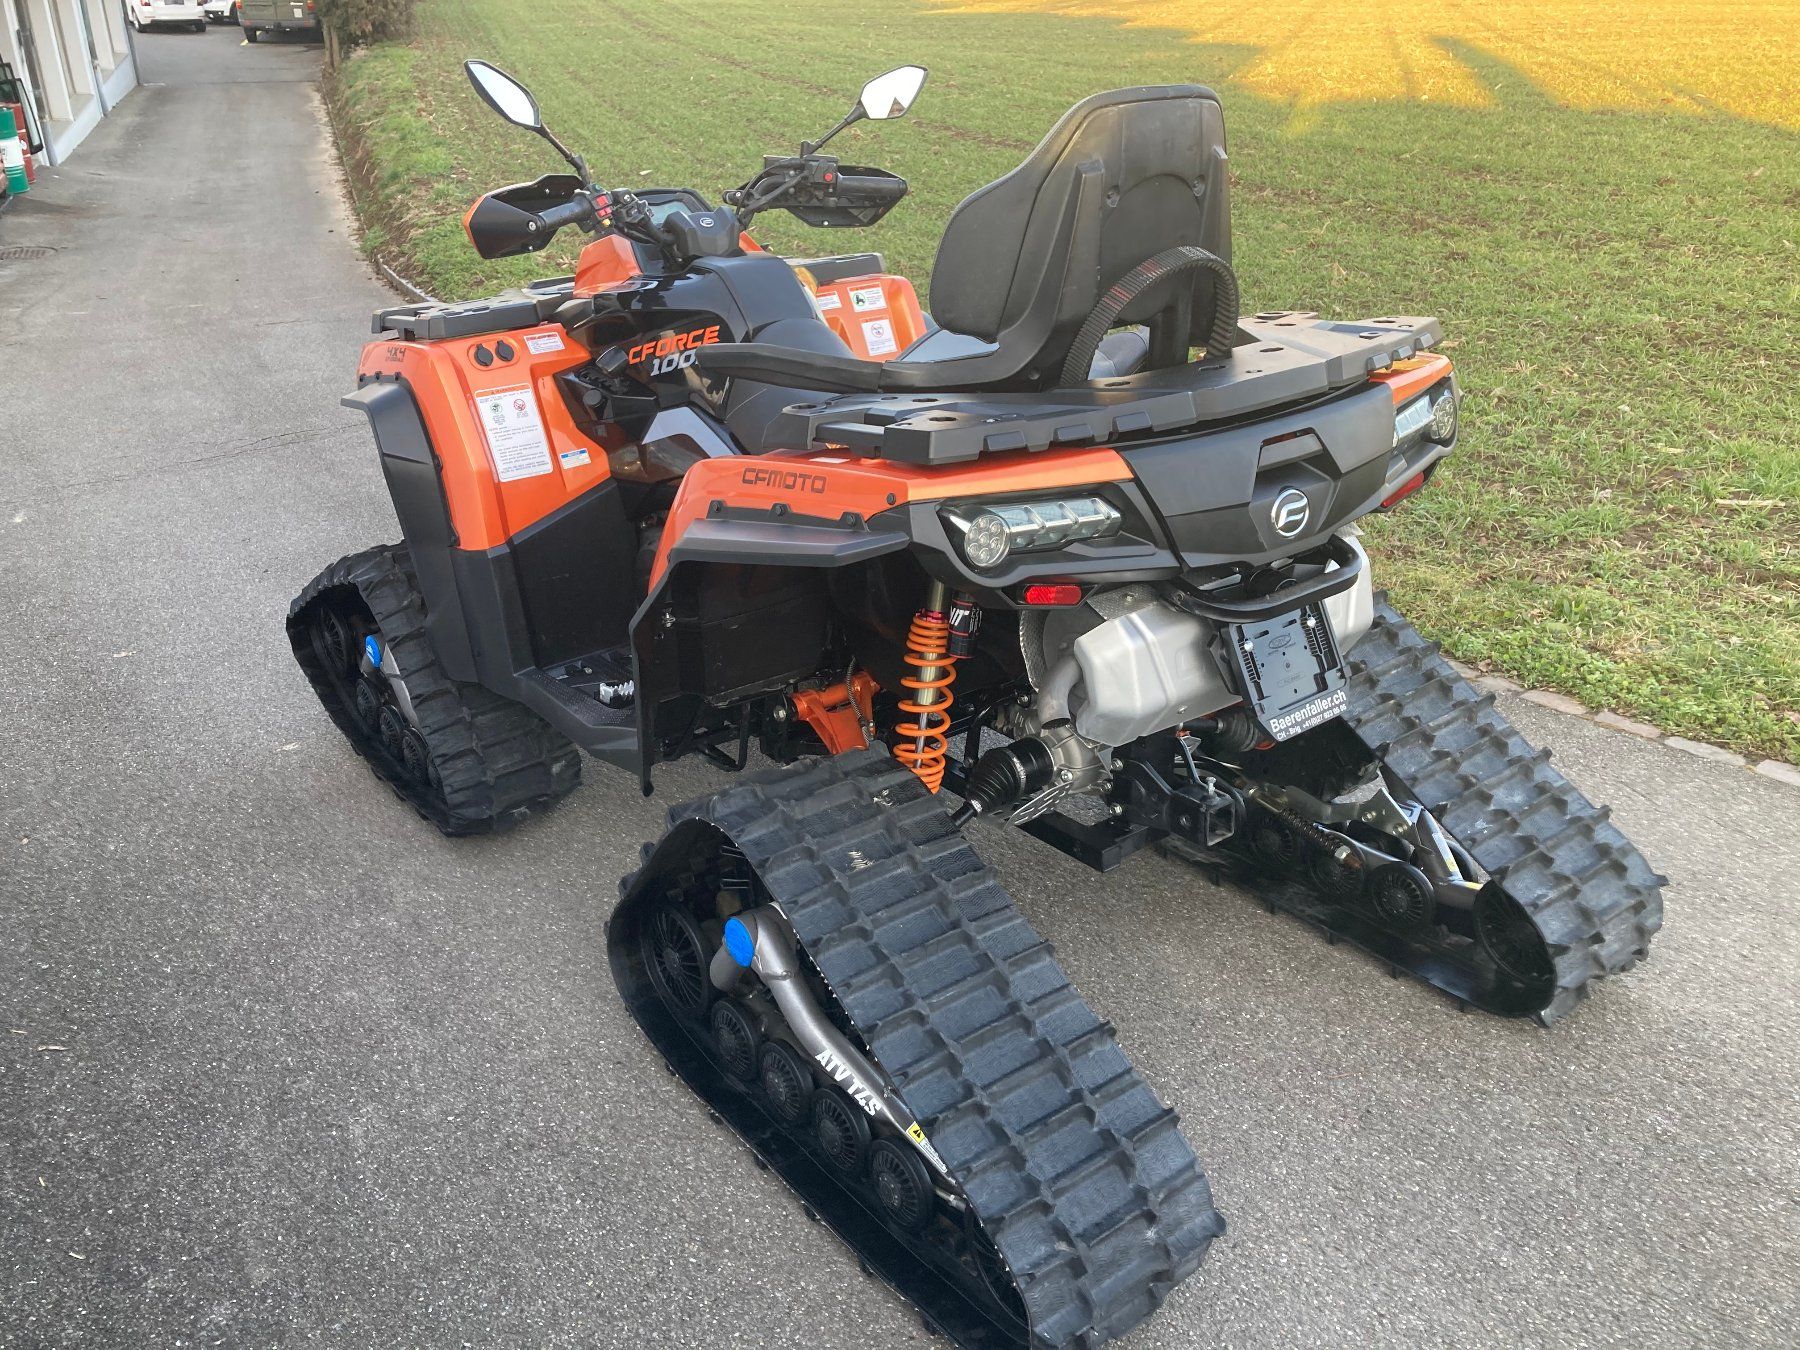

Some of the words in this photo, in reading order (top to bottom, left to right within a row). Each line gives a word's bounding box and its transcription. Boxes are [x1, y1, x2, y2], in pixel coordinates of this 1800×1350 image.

[628, 325, 720, 365] CFORCE
[650, 349, 699, 377] 100
[742, 467, 827, 494] CFMOTO
[1269, 689, 1347, 733] Baerenfaller.ch
[815, 1049, 853, 1082] ATV
